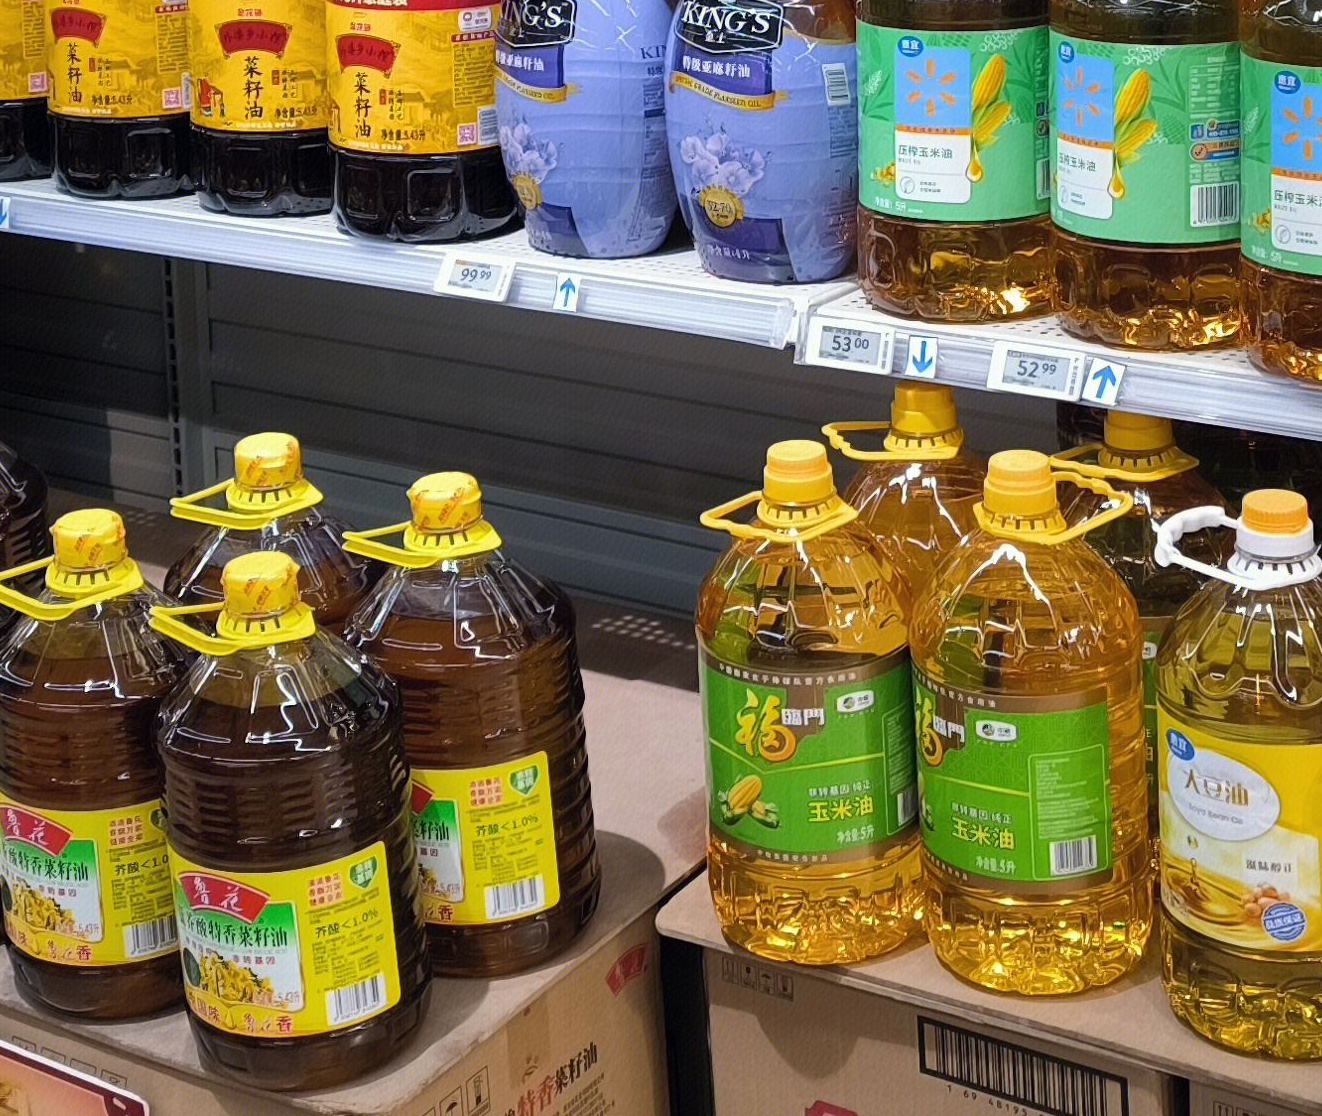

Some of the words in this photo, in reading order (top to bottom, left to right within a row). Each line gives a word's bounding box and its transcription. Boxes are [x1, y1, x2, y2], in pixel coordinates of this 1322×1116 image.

[681, 1, 771, 34] KING'S
[67, 44, 82, 102] 菜籽油
[683, 55, 750, 78] 特级亚麻籽油
[243, 56, 263, 120] 菜籽油
[353, 73, 371, 138] 菜籽油
[898, 145, 953, 159] 压榨玉米油
[1059, 153, 1096, 172] 压榨玉米油
[1183, 767, 1249, 807] 大豆油
[808, 794, 873, 823] 玉米油
[4, 810, 49, 846] 鲁花
[952, 817, 1015, 849] 玉米油
[194, 877, 243, 911] 鲁花
